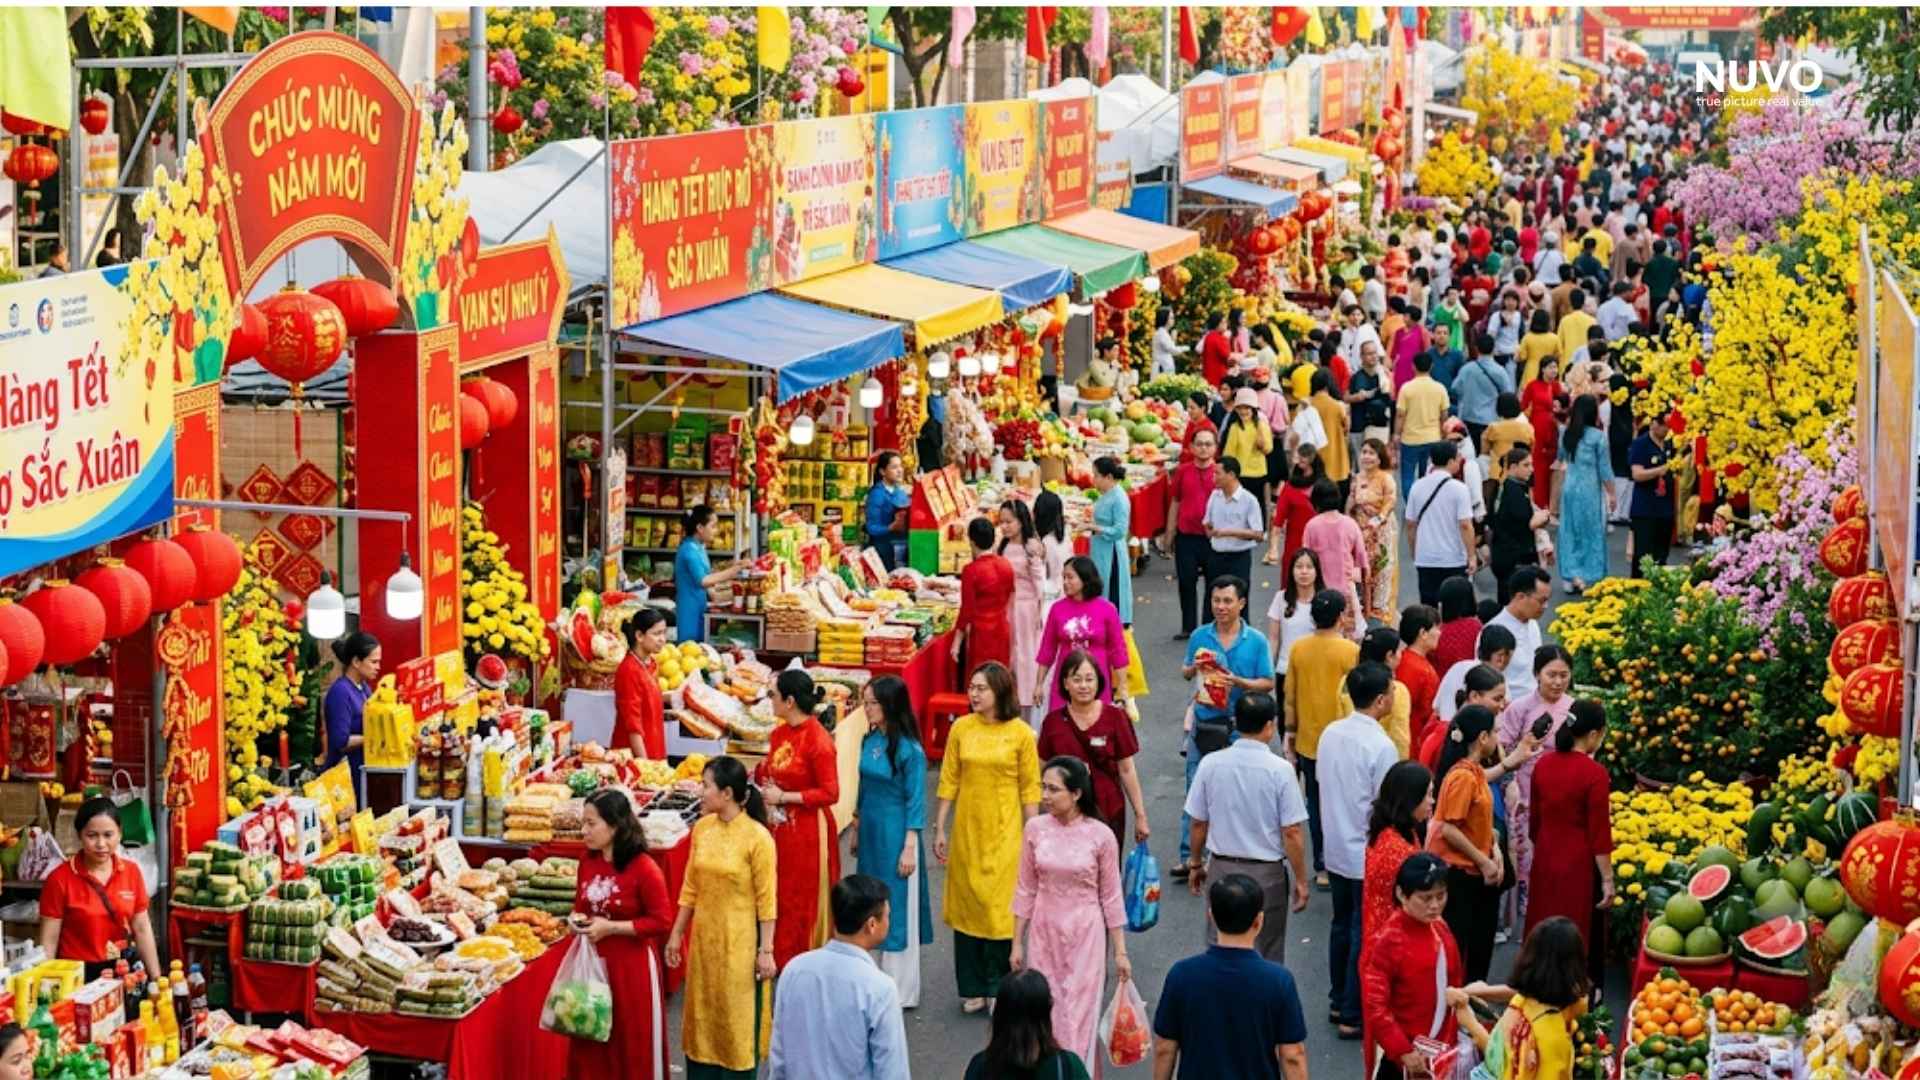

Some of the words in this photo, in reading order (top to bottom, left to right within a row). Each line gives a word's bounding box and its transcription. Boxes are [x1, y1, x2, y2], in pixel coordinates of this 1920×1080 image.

[249, 77, 313, 157] CHÚC
[318, 73, 382, 145] MỪNG
[268, 148, 320, 217] NĂM
[326, 145, 367, 203] MỚI
[642, 170, 679, 226] HÀNG
[682, 156, 705, 218] TẾT
[667, 226, 694, 289] SẮC
[696, 227, 730, 284] XUÂN
[460, 289, 489, 342] VẠN
[68, 341, 109, 410] Tết
[22, 437, 68, 508] Sắc
[76, 430, 140, 492] Xuân
